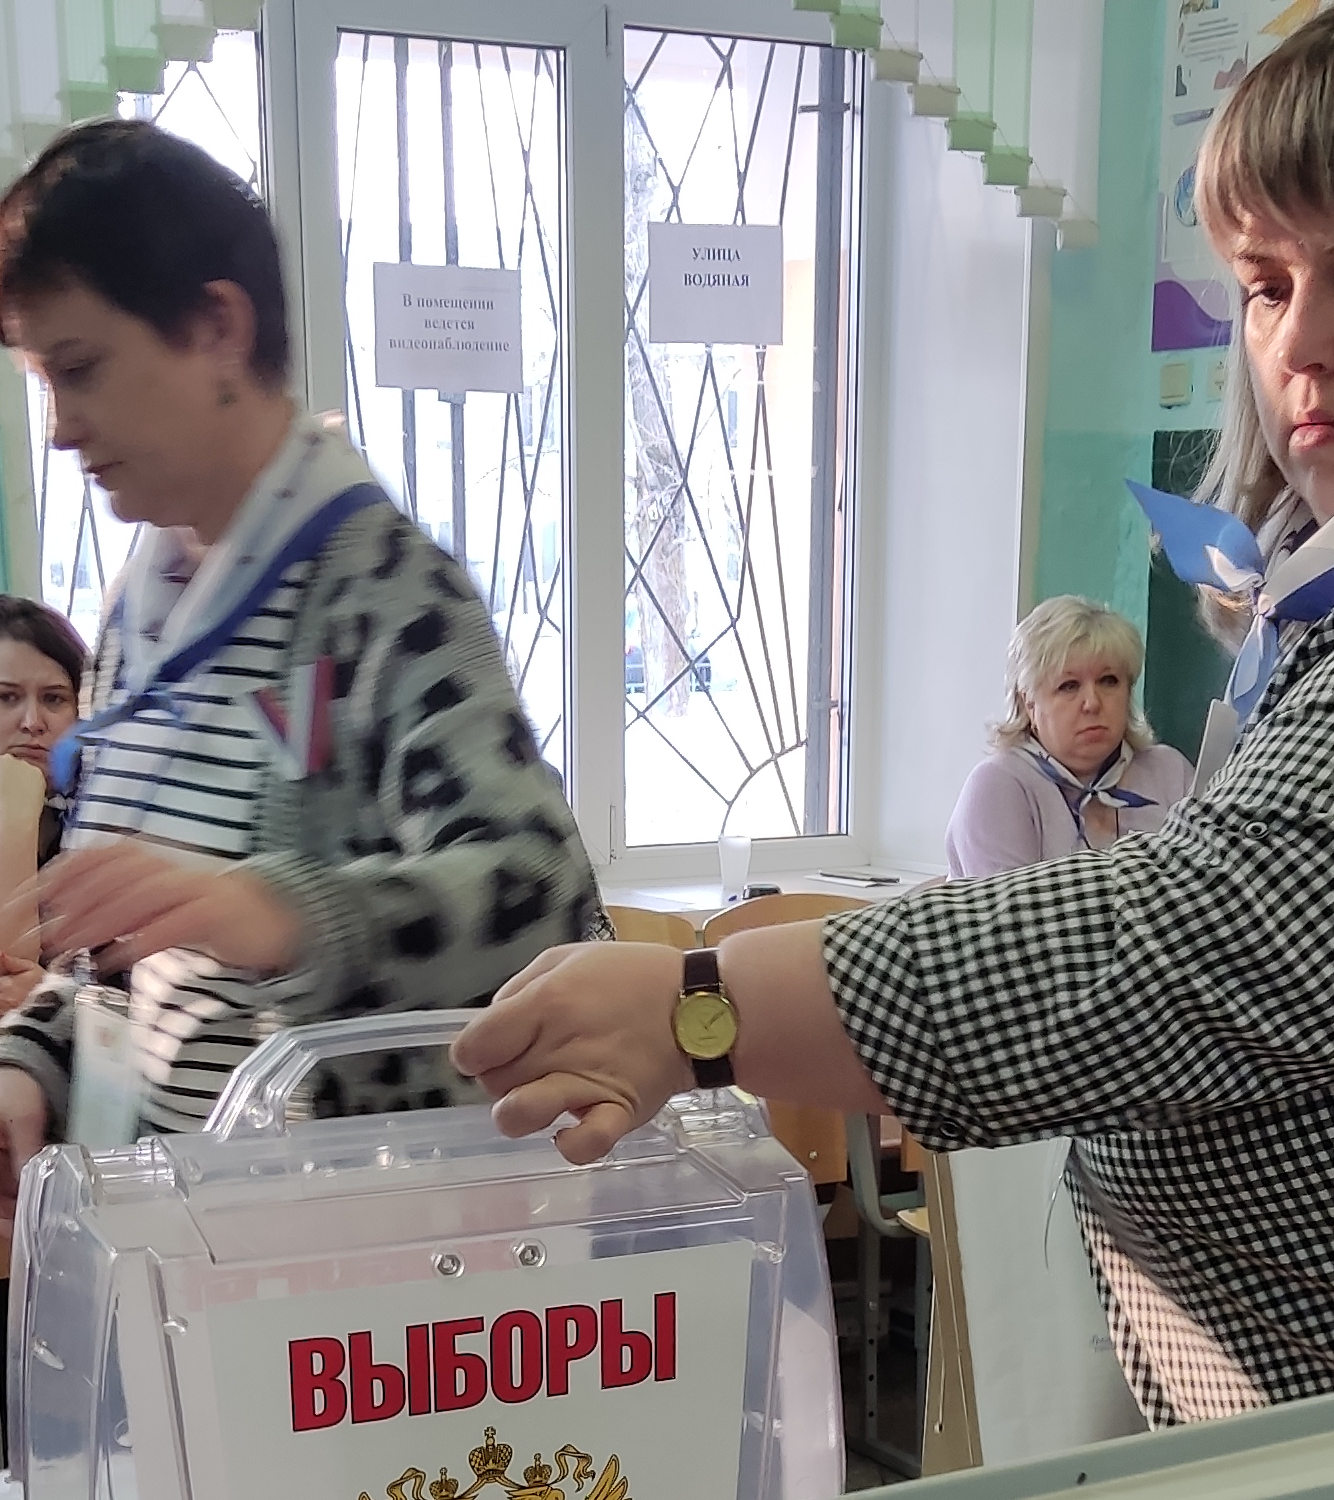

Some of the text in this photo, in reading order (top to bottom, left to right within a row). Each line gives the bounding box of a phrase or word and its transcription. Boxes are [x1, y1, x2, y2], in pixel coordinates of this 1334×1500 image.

[692, 247, 741, 263] УЛИЦА
[684, 273, 749, 288] ВОДЯНАЯ
[402, 293, 494, 310] В помещении
[389, 337, 510, 352] видеонаблюдение
[288, 1291, 677, 1432] ВЫБОРЫ
